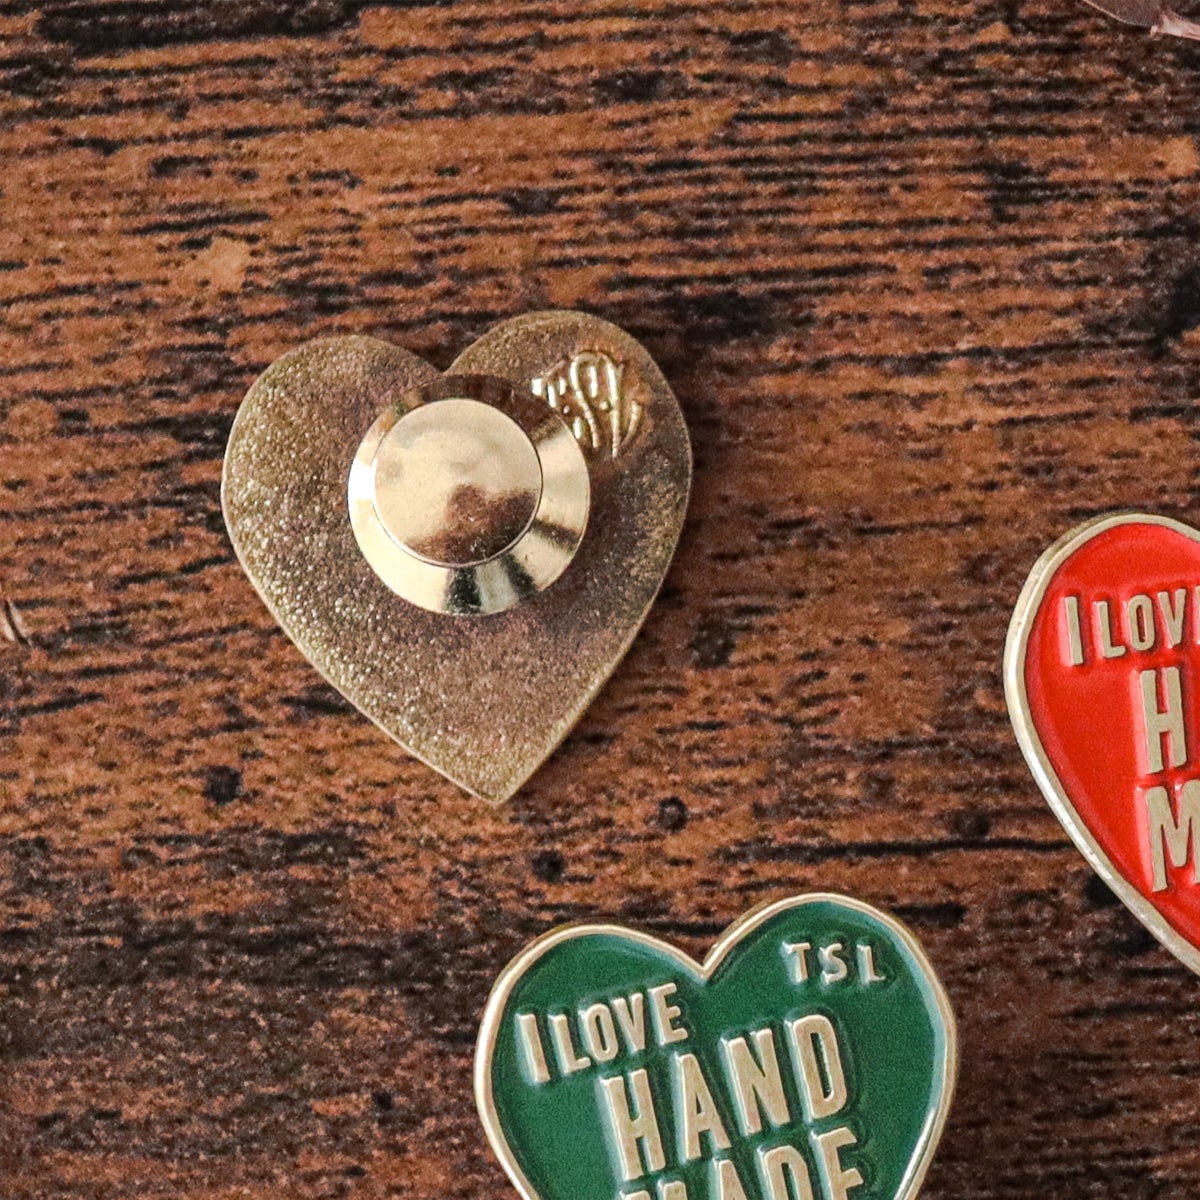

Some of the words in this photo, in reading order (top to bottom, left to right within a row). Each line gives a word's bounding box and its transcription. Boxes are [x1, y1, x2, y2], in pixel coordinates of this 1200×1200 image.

[1060, 595, 1084, 667] I
[516, 1012, 550, 1086] I
[549, 982, 689, 1076] LOVE
[600, 1013, 847, 1182] HAND
